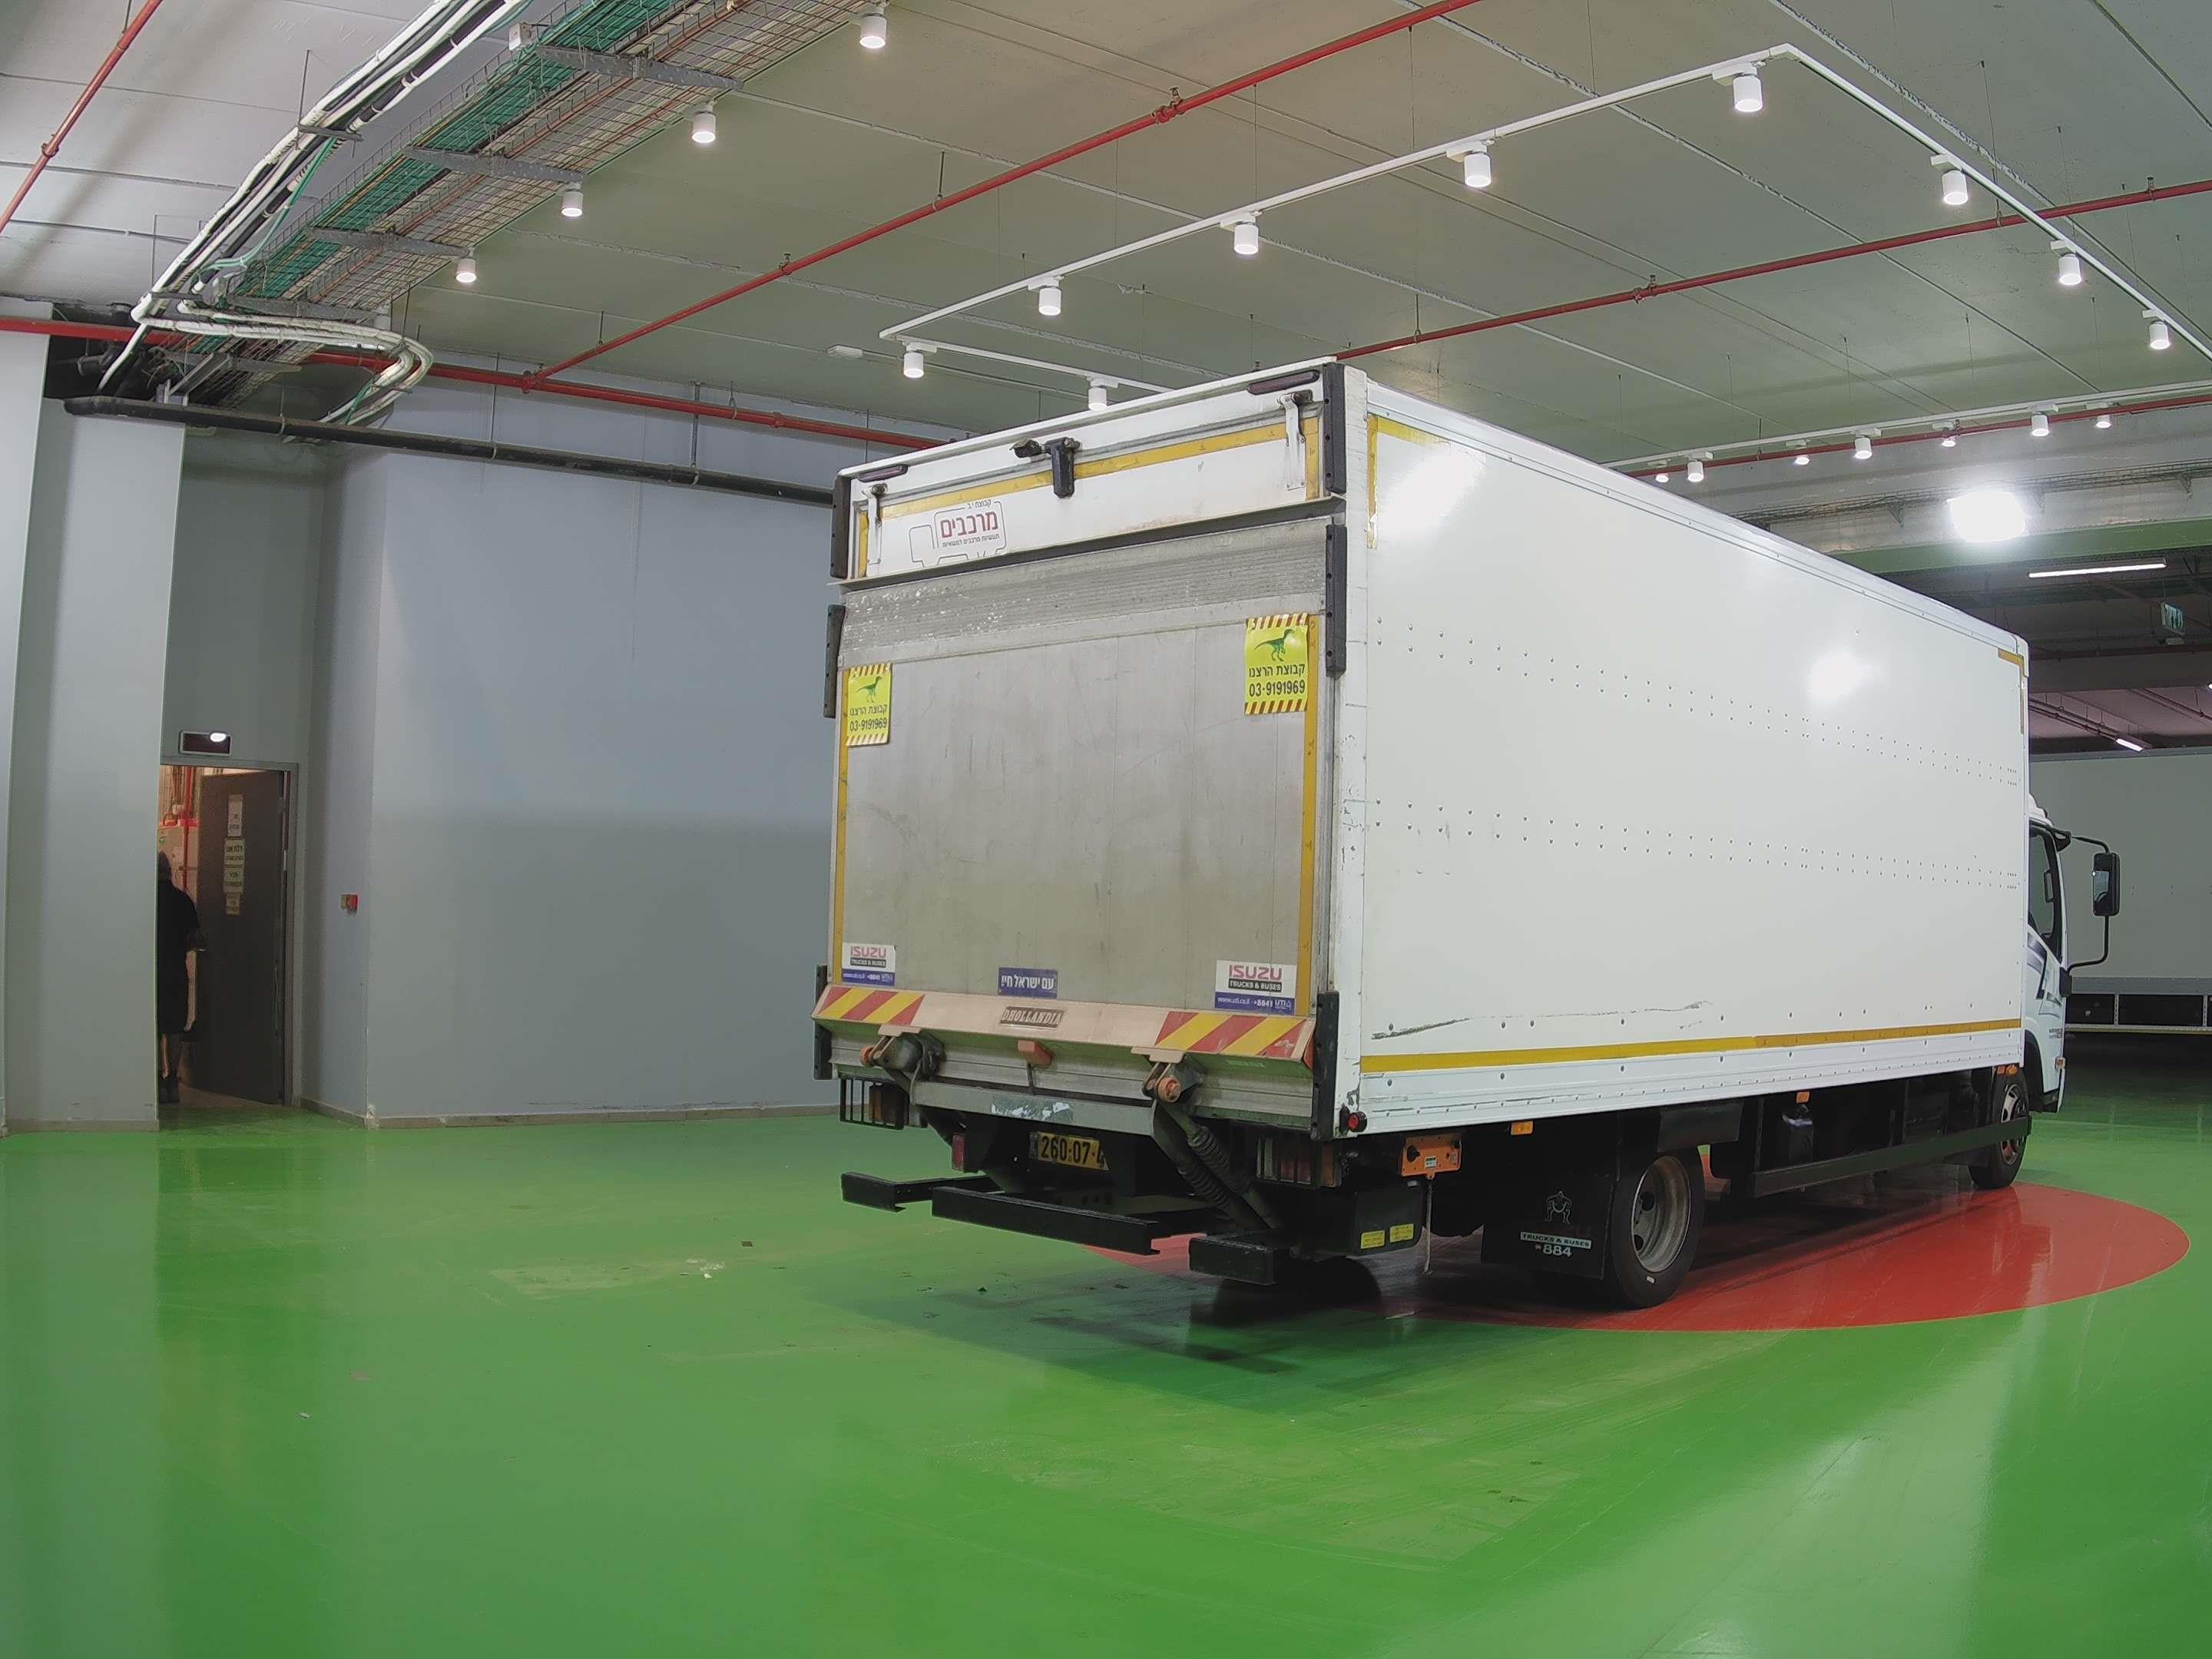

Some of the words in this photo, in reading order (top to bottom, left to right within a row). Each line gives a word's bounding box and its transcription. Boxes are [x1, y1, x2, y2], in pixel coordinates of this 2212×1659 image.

[939, 511, 998, 538] מרכבים
[1276, 664, 1306, 677] קבוצת
[1249, 679, 1306, 697] 03-9191969
[869, 704, 888, 715] קבוצת
[849, 717, 888, 732] 03-9191969
[850, 945, 886, 959] ISUZU
[1229, 964, 1283, 981] ISUZU
[1014, 974, 1041, 989] ישראל
[1041, 977, 1055, 990] עם
[1001, 1008, 1063, 1025] DHOLLANDIA
[1523, 1233, 1555, 1243] TRUCKS
